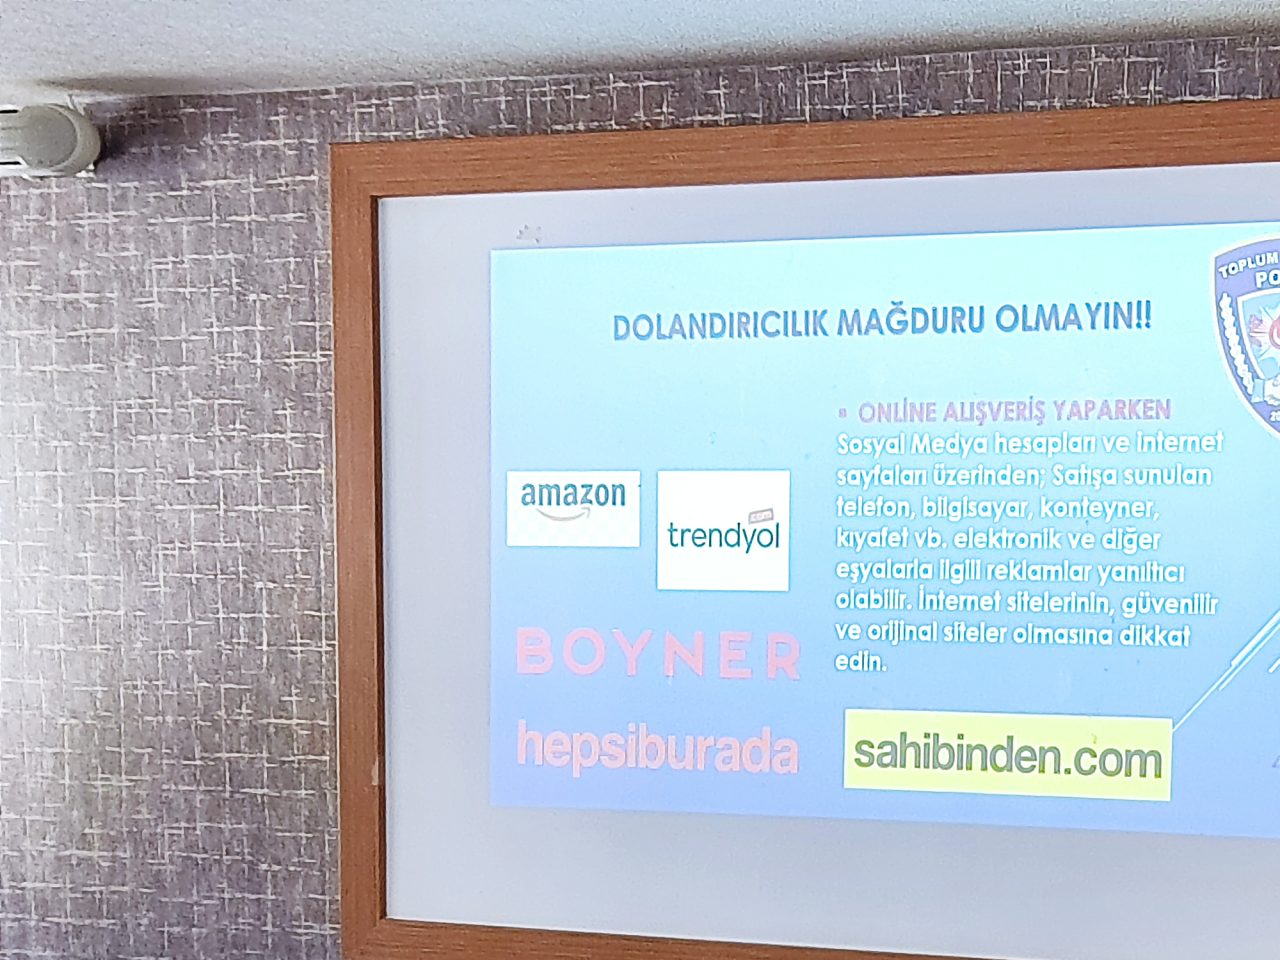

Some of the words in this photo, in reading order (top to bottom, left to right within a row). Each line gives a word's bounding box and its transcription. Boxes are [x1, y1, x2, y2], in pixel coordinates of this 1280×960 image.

[1218, 251, 1279, 279] TOPLUM
[613, 309, 829, 342] DOLANDIRICILIK
[836, 300, 985, 337] MAĞDURU
[995, 300, 1152, 333] OLMAYIN!!
[858, 397, 937, 423] ONLİNE
[943, 395, 1046, 426] ALIŞVERİŞ
[1053, 397, 1172, 421] YAPARKEN
[836, 433, 906, 459] Sosyal
[910, 434, 988, 459] Medya
[994, 432, 1096, 457] hesapları
[1102, 436, 1131, 453] ve
[1136, 430, 1224, 453] internet
[836, 465, 928, 489] sayfaları
[932, 464, 1048, 489] üzerinden;
[1052, 464, 1117, 490] Satışa
[1123, 464, 1213, 487] sunulan
[521, 483, 626, 506] amazon
[836, 496, 917, 520] telefon,
[922, 496, 1034, 522] bilgisayar,
[1040, 496, 1160, 522] konteyner,
[667, 522, 780, 554] trendyol
[836, 527, 910, 554] kıyafet
[914, 527, 948, 551] vb.
[954, 527, 1063, 550] elektronik
[1068, 532, 1096, 550] ve
[1101, 526, 1161, 554] diğer
[835, 558, 933, 583] eşyalarla
[939, 559, 981, 583] ilgili
[986, 559, 1092, 582] reklamlar
[1097, 560, 1185, 586] yanıltıcı
[835, 589, 913, 610] olabilir.
[918, 584, 1002, 612] İnternet
[1006, 590, 1116, 617] sitelerinin,
[1121, 592, 1219, 618] güvenilir
[835, 623, 862, 641] ve
[867, 619, 938, 646] orijinal
[943, 620, 1008, 645] siteler
[1012, 623, 1113, 646] olmasına
[1119, 625, 1191, 648] dikkat
[516, 627, 801, 680] BOYNER
[835, 650, 887, 672] edin.
[516, 718, 800, 778] hepsiburada
[854, 732, 1162, 779] sahibinden.com
